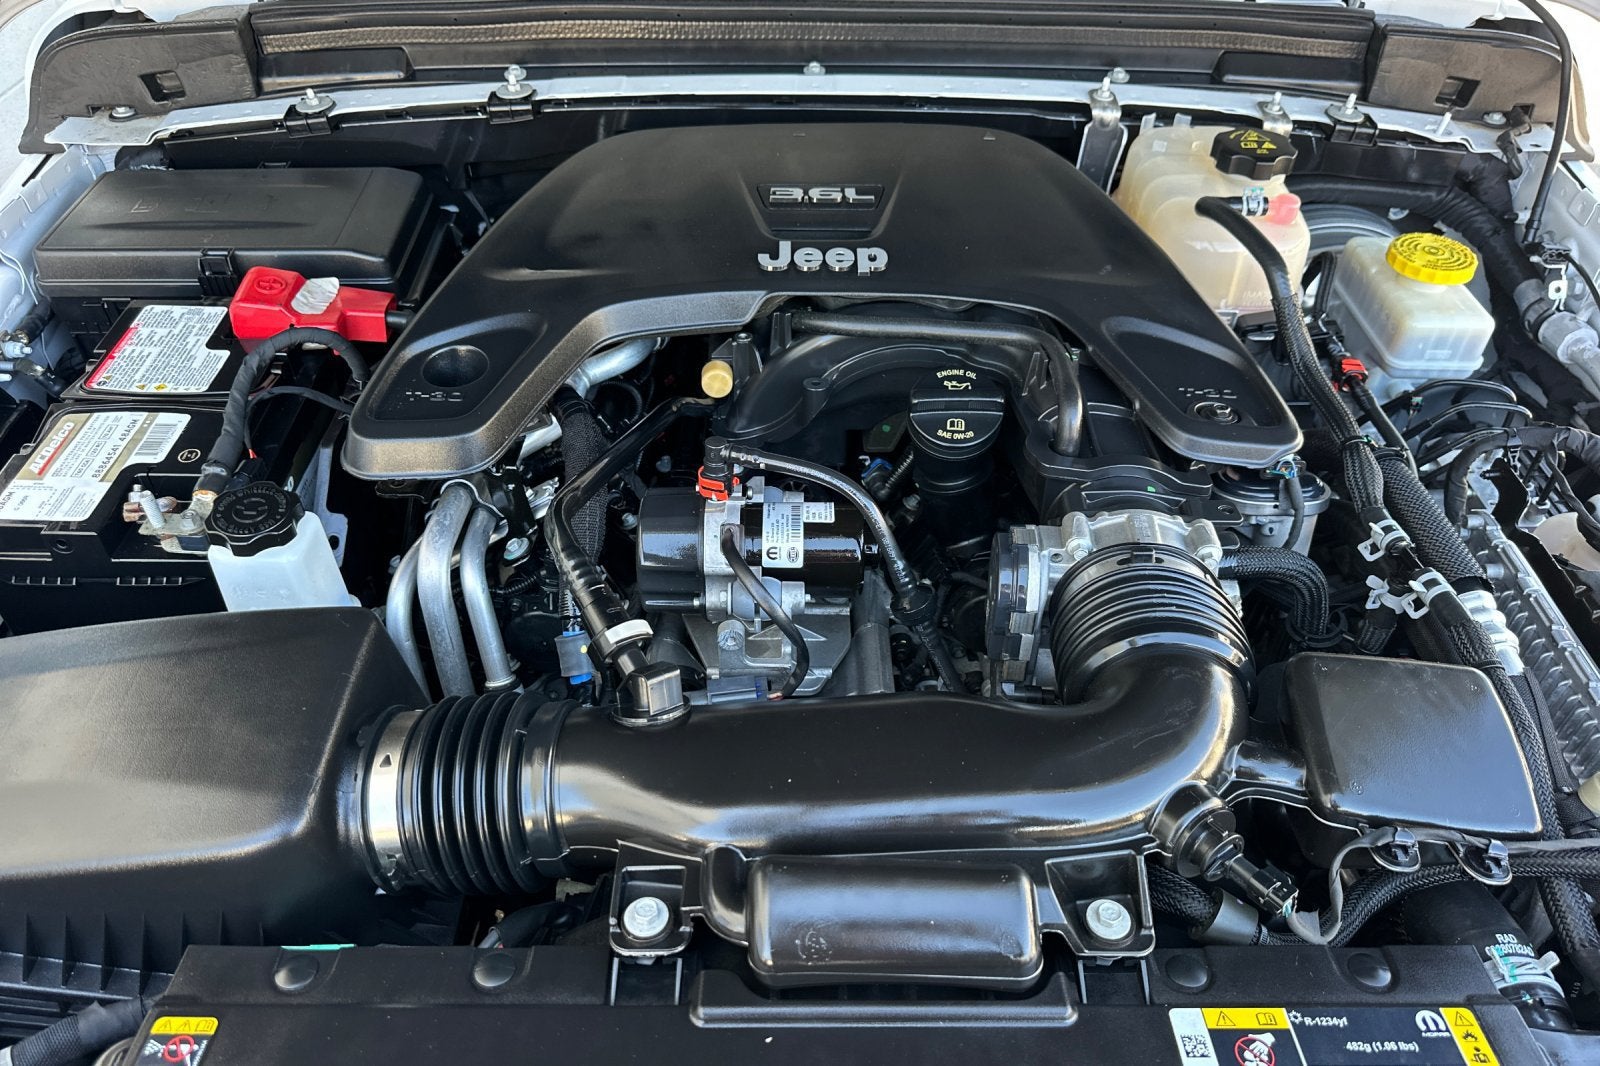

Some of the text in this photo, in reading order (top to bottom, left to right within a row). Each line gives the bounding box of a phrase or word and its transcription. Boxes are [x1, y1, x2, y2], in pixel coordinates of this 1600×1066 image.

[769, 187, 875, 203] 3.6L
[757, 240, 889, 276] Jeep
[936, 369, 977, 380] ENGINE OIL
[936, 429, 975, 440] SAE 0W-20
[91, 444, 121, 478] 88864541
[118, 419, 140, 442] 48AGM
[1495, 933, 1518, 943] RAD
[1346, 1041, 1371, 1053] 482g
[1398, 1041, 1419, 1053] lbs)
